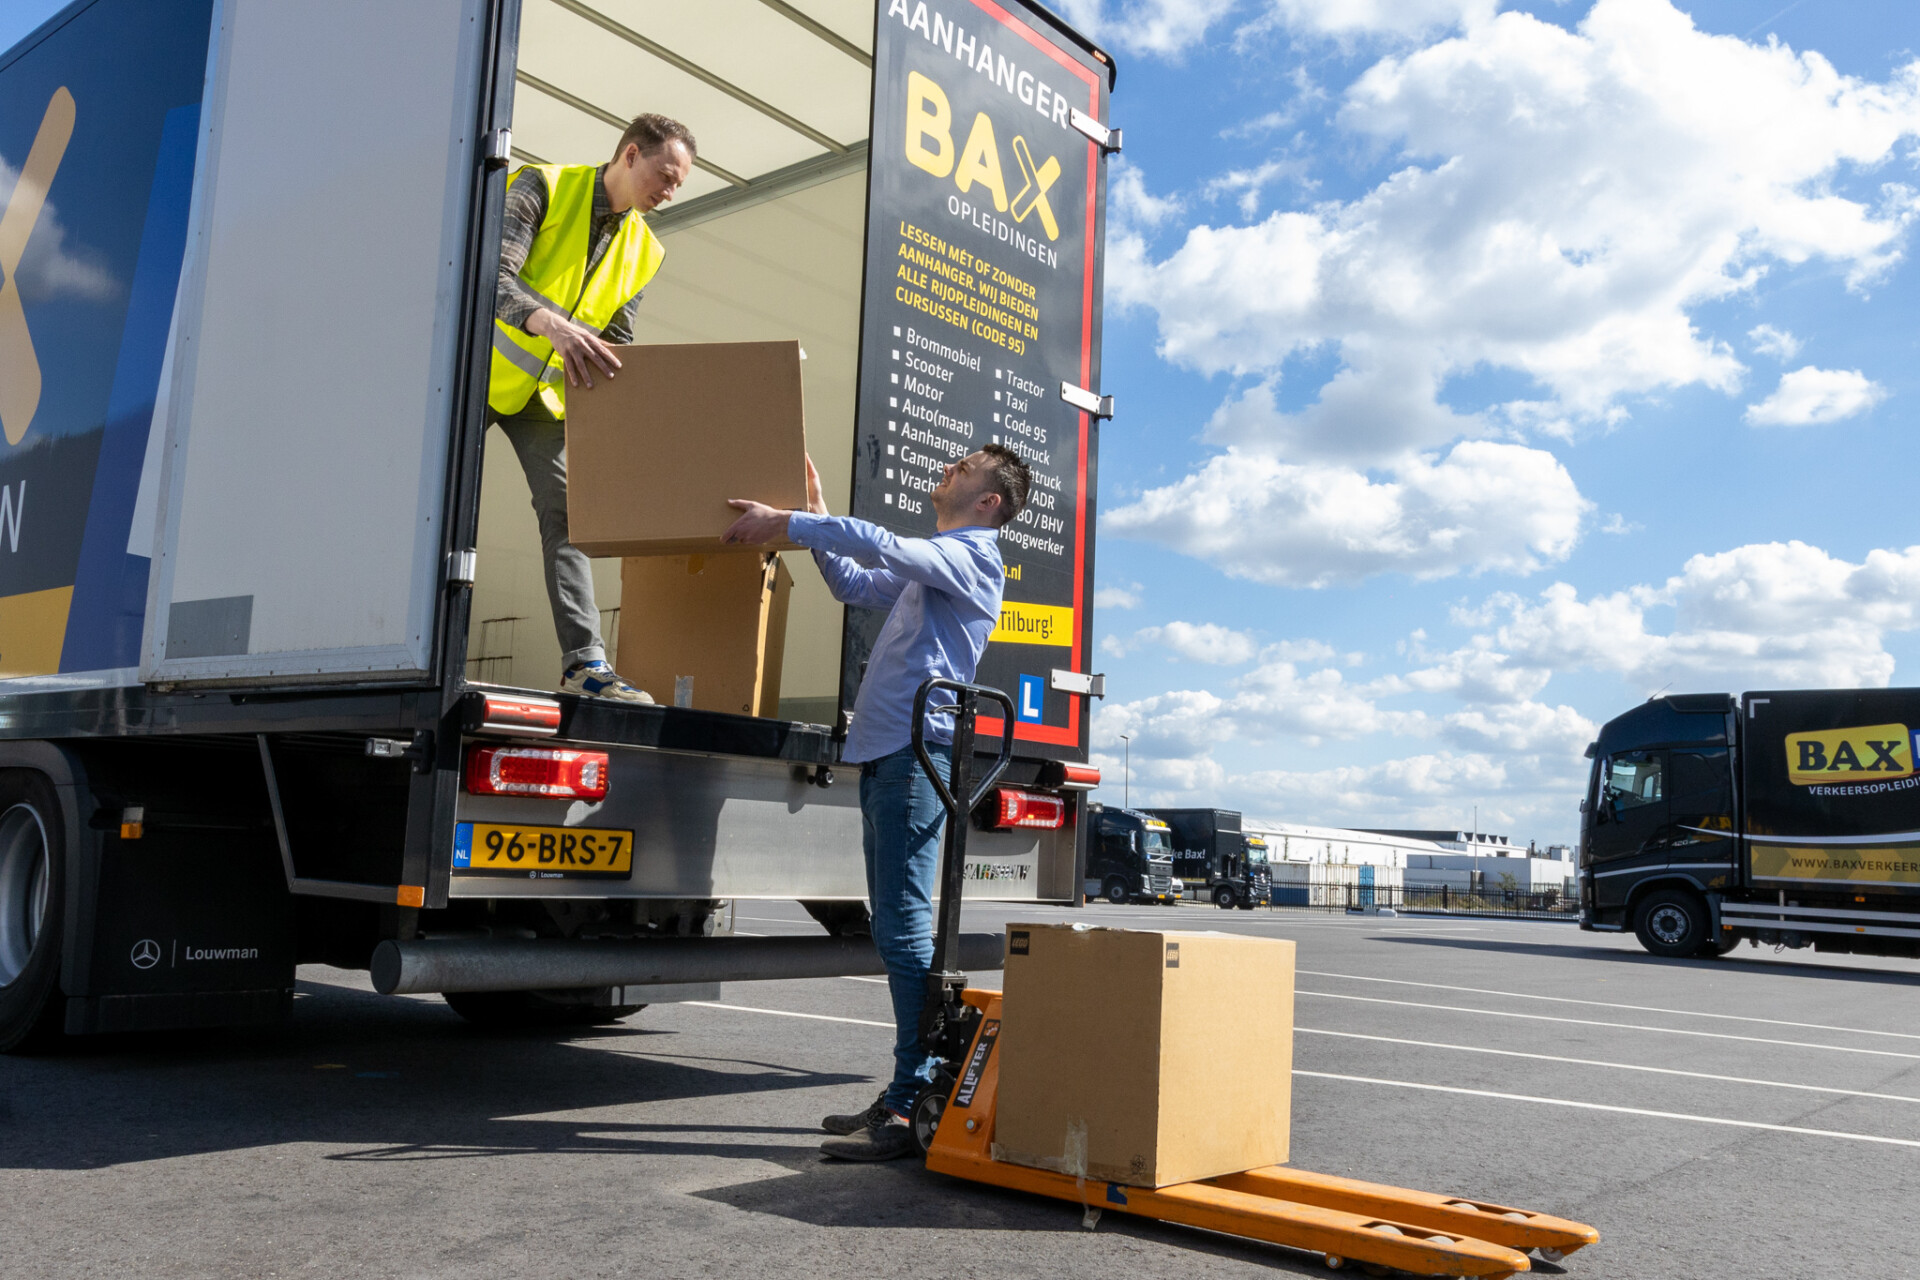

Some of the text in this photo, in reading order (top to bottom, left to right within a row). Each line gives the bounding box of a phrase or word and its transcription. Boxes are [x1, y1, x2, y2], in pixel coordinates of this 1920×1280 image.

[888, 0, 1068, 130] AANHANGER
[905, 70, 1061, 241] BAX
[948, 195, 1058, 269] OPLEIDINGEN
[900, 221, 1036, 300] LESSEN MÉT OF ZONDER
[898, 243, 1039, 321] AANHANGER. WIJ BIEDEN
[897, 264, 1038, 341] ALLE RIJOPLEIDINGEN EN
[895, 286, 1025, 356] CURSUSSEN (CODE 95)
[906, 327, 981, 372] Brommobiel
[905, 351, 954, 383] Scooter
[904, 374, 944, 402] Motor
[1006, 369, 1045, 398] Tractor
[1006, 391, 1028, 413] Taxi
[902, 398, 974, 439] Auto(maat)
[1004, 414, 1047, 444] Code 95
[901, 422, 969, 458] Aanhanger
[1004, 435, 1050, 466] Heftruck
[901, 445, 946, 474] Campe
[898, 493, 922, 515] Bus
[1032, 490, 1055, 510] ADR
[1013, 508, 1033, 524] BO
[1041, 514, 1064, 534] BHV
[1000, 524, 1064, 556] Hoogwerker
[1000, 610, 1053, 639] Tilburg!
[1023, 681, 1040, 718] L
[1796, 740, 1904, 772] BAX
[455, 849, 469, 860] NL
[485, 830, 624, 866] 96-BRS-7
[1185, 848, 1206, 860] Bax!
[186, 946, 258, 960] Louwman
[1011, 937, 1029, 948] LEGO
[1167, 949, 1179, 961] LEGO
[957, 1042, 988, 1105] ALLIFTER
